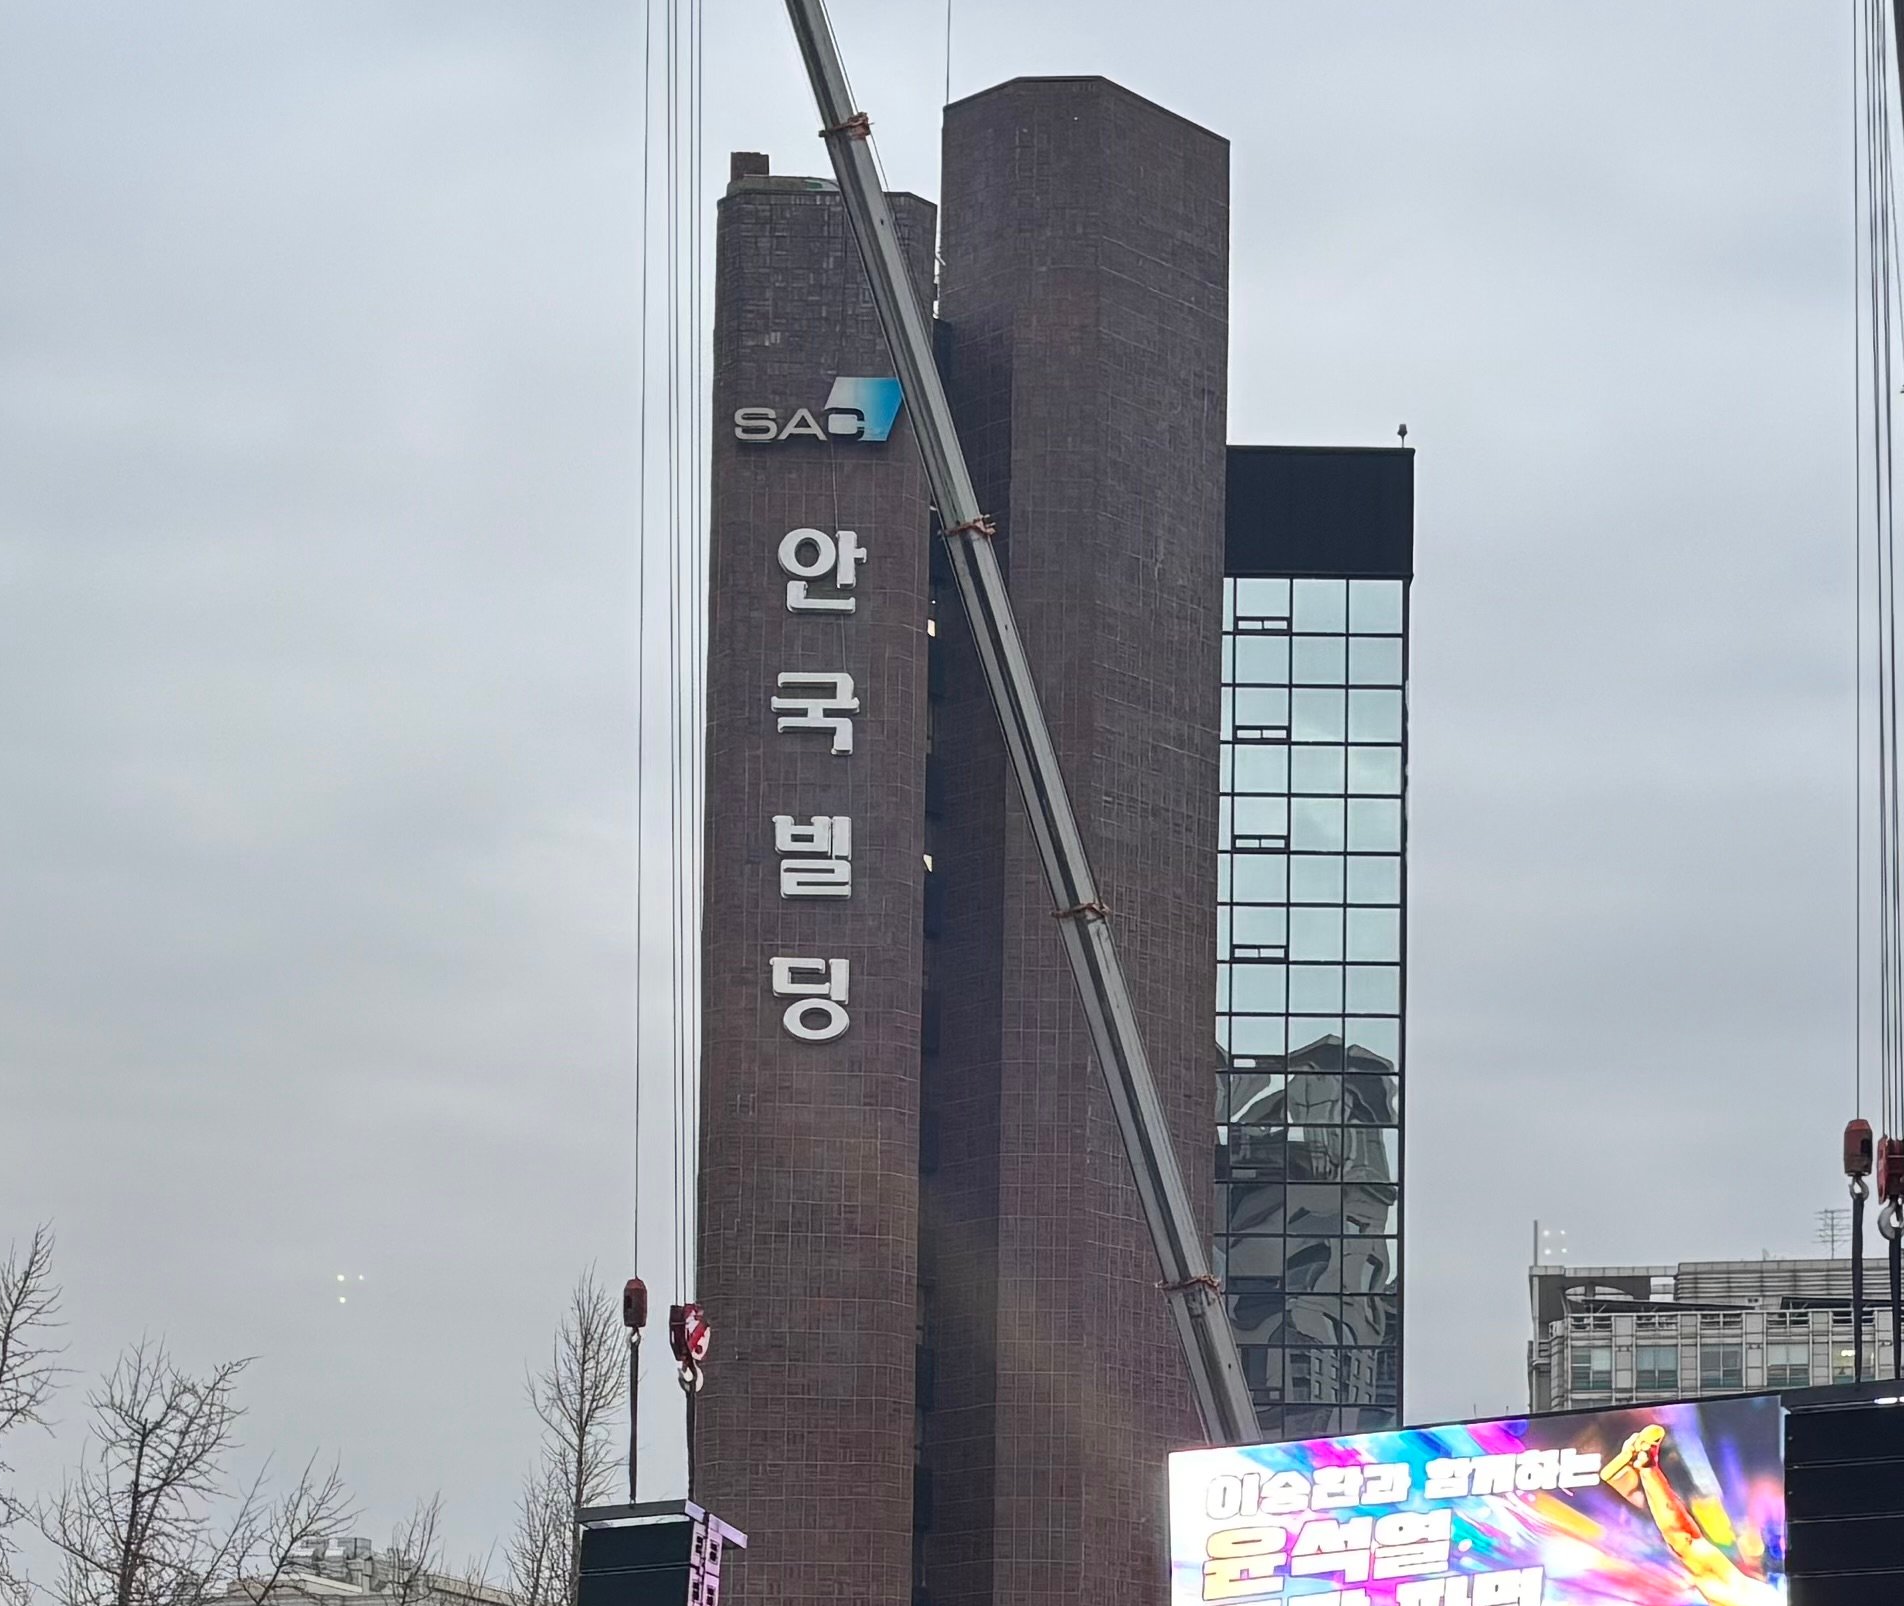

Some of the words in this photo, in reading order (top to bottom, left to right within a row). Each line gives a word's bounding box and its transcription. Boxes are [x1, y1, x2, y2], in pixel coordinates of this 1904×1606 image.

[769, 527, 867, 1044] 안국빌딩
[1426, 1448, 1602, 1500] 함께하는
[1203, 1509, 1453, 1600] 윤석열
